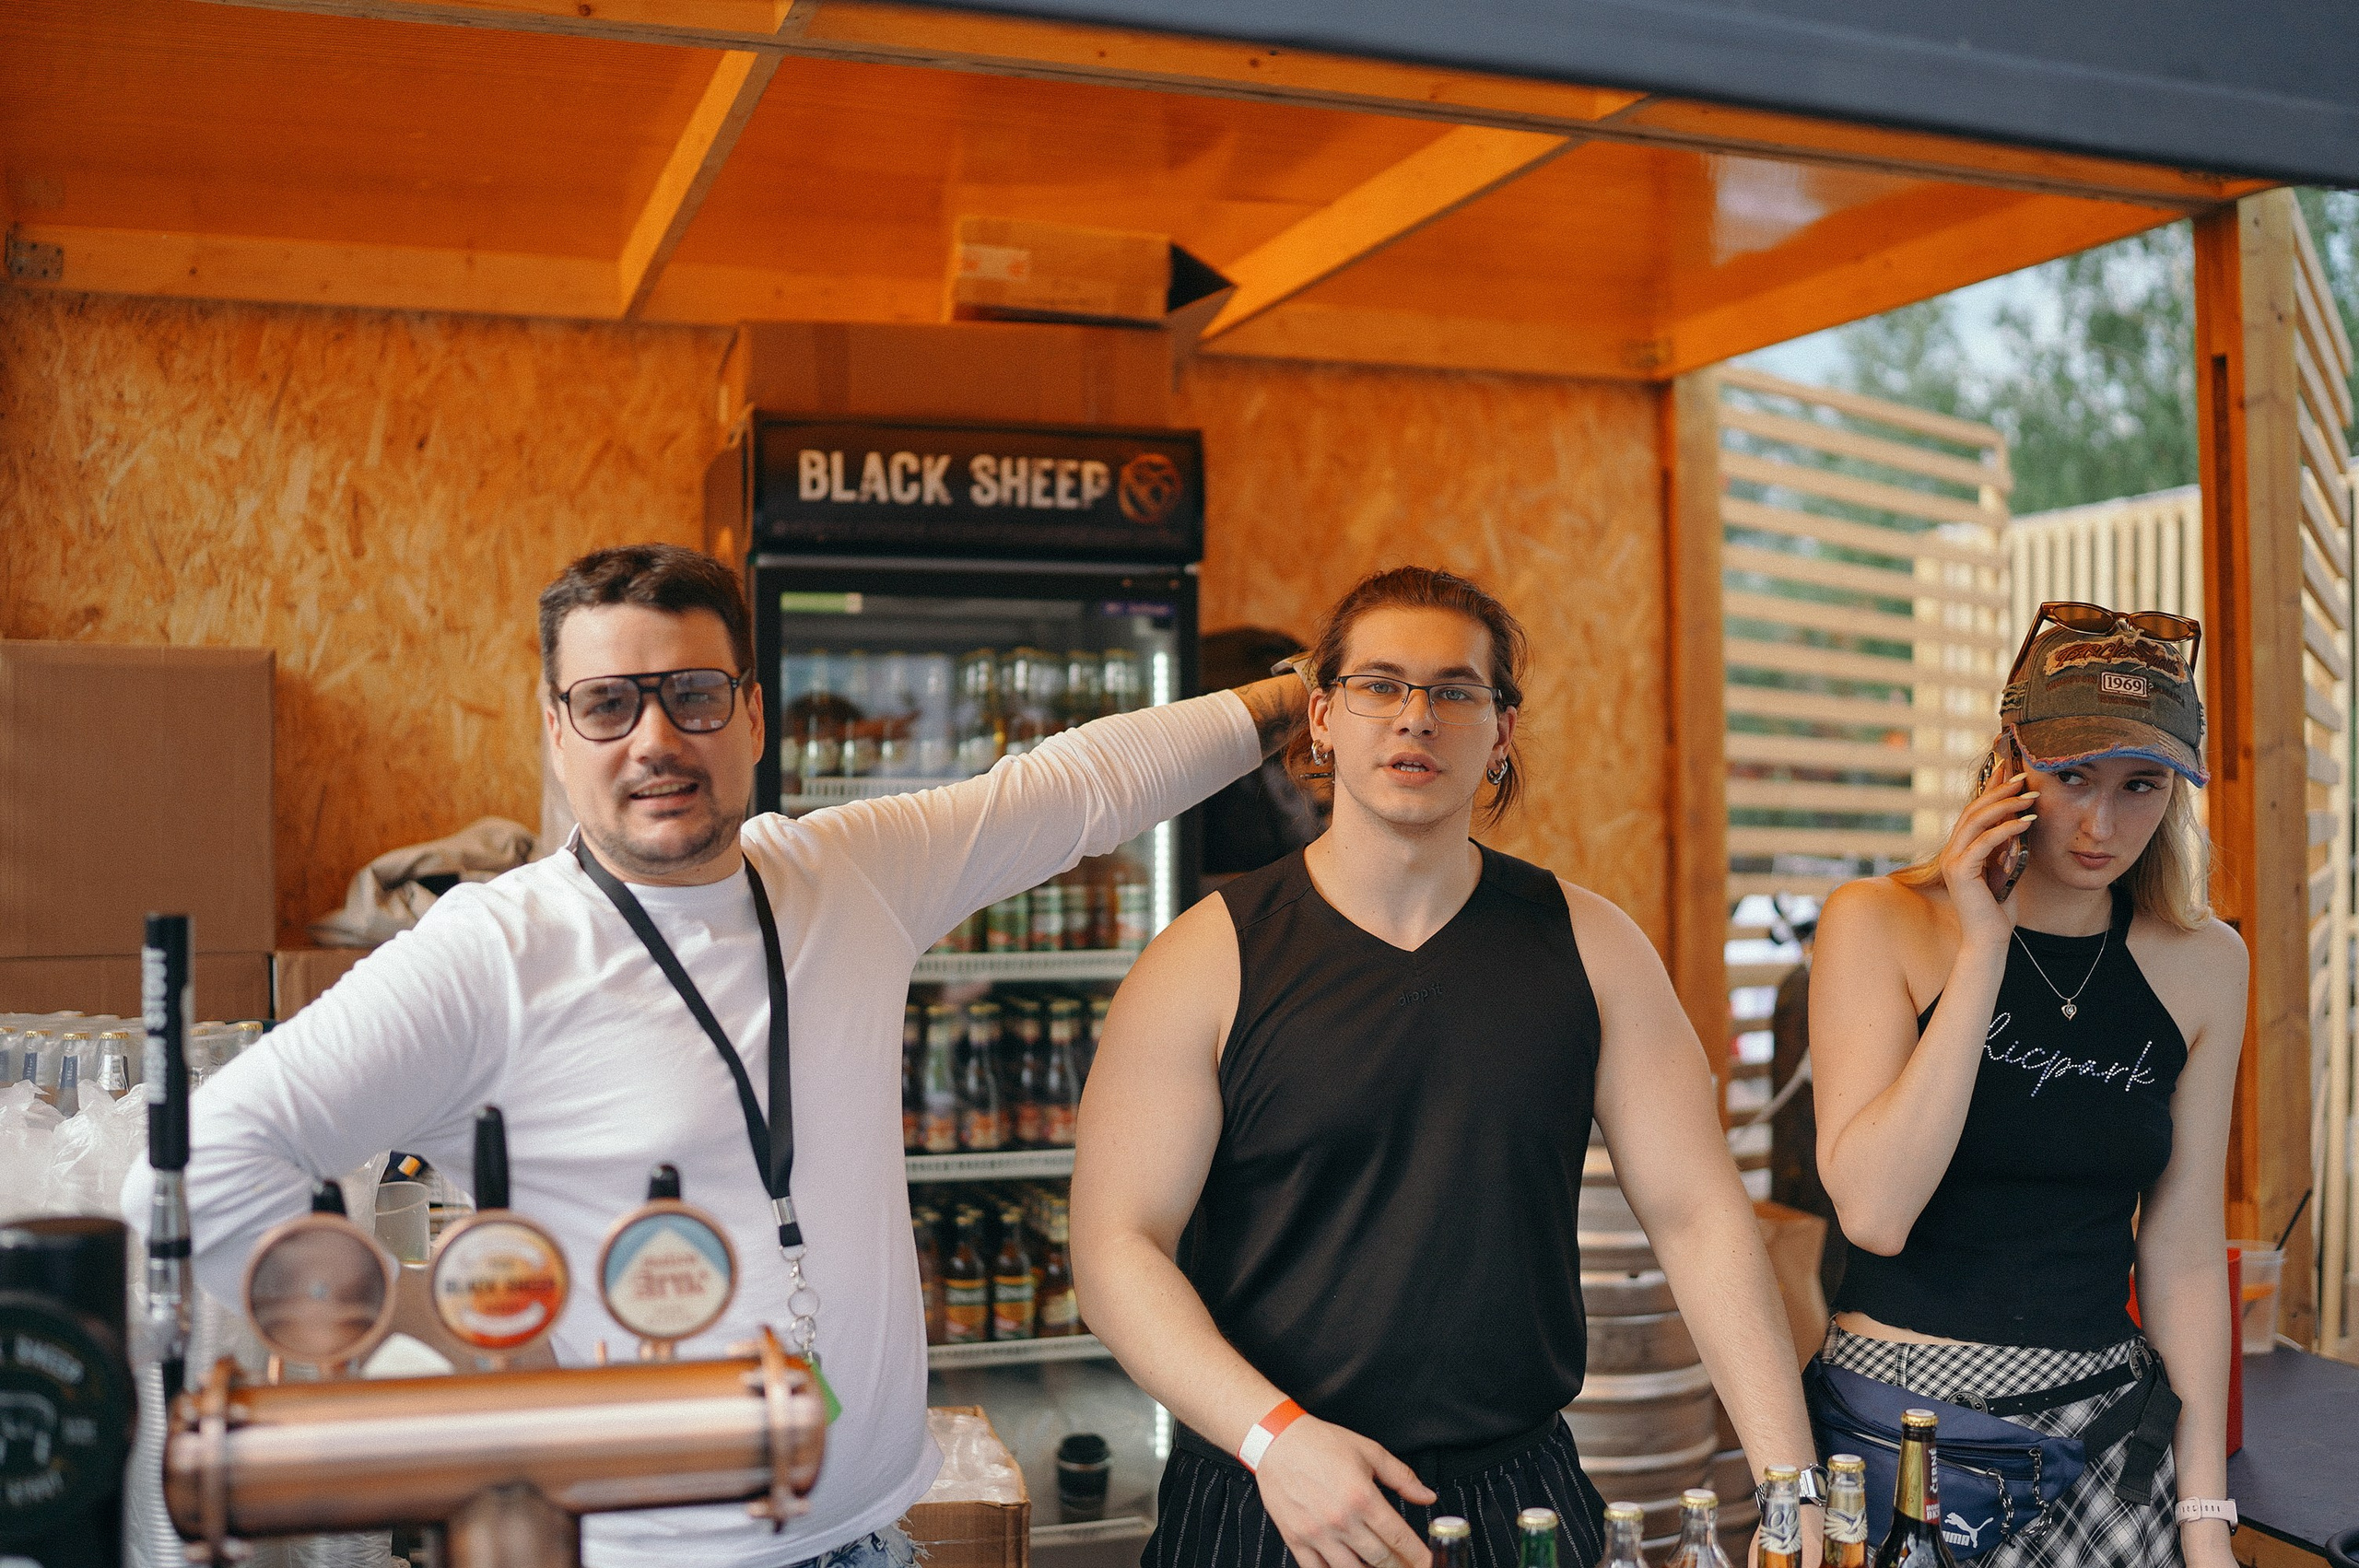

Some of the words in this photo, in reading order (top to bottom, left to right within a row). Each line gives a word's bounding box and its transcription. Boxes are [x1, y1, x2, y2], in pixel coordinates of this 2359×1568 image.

[798, 449, 955, 506] BLACK
[969, 454, 1109, 510] SHEEP
[2107, 675, 2143, 693] 1969
[1984, 1012, 2155, 1097] hicpark
[1942, 1530, 1970, 1548] UMA
